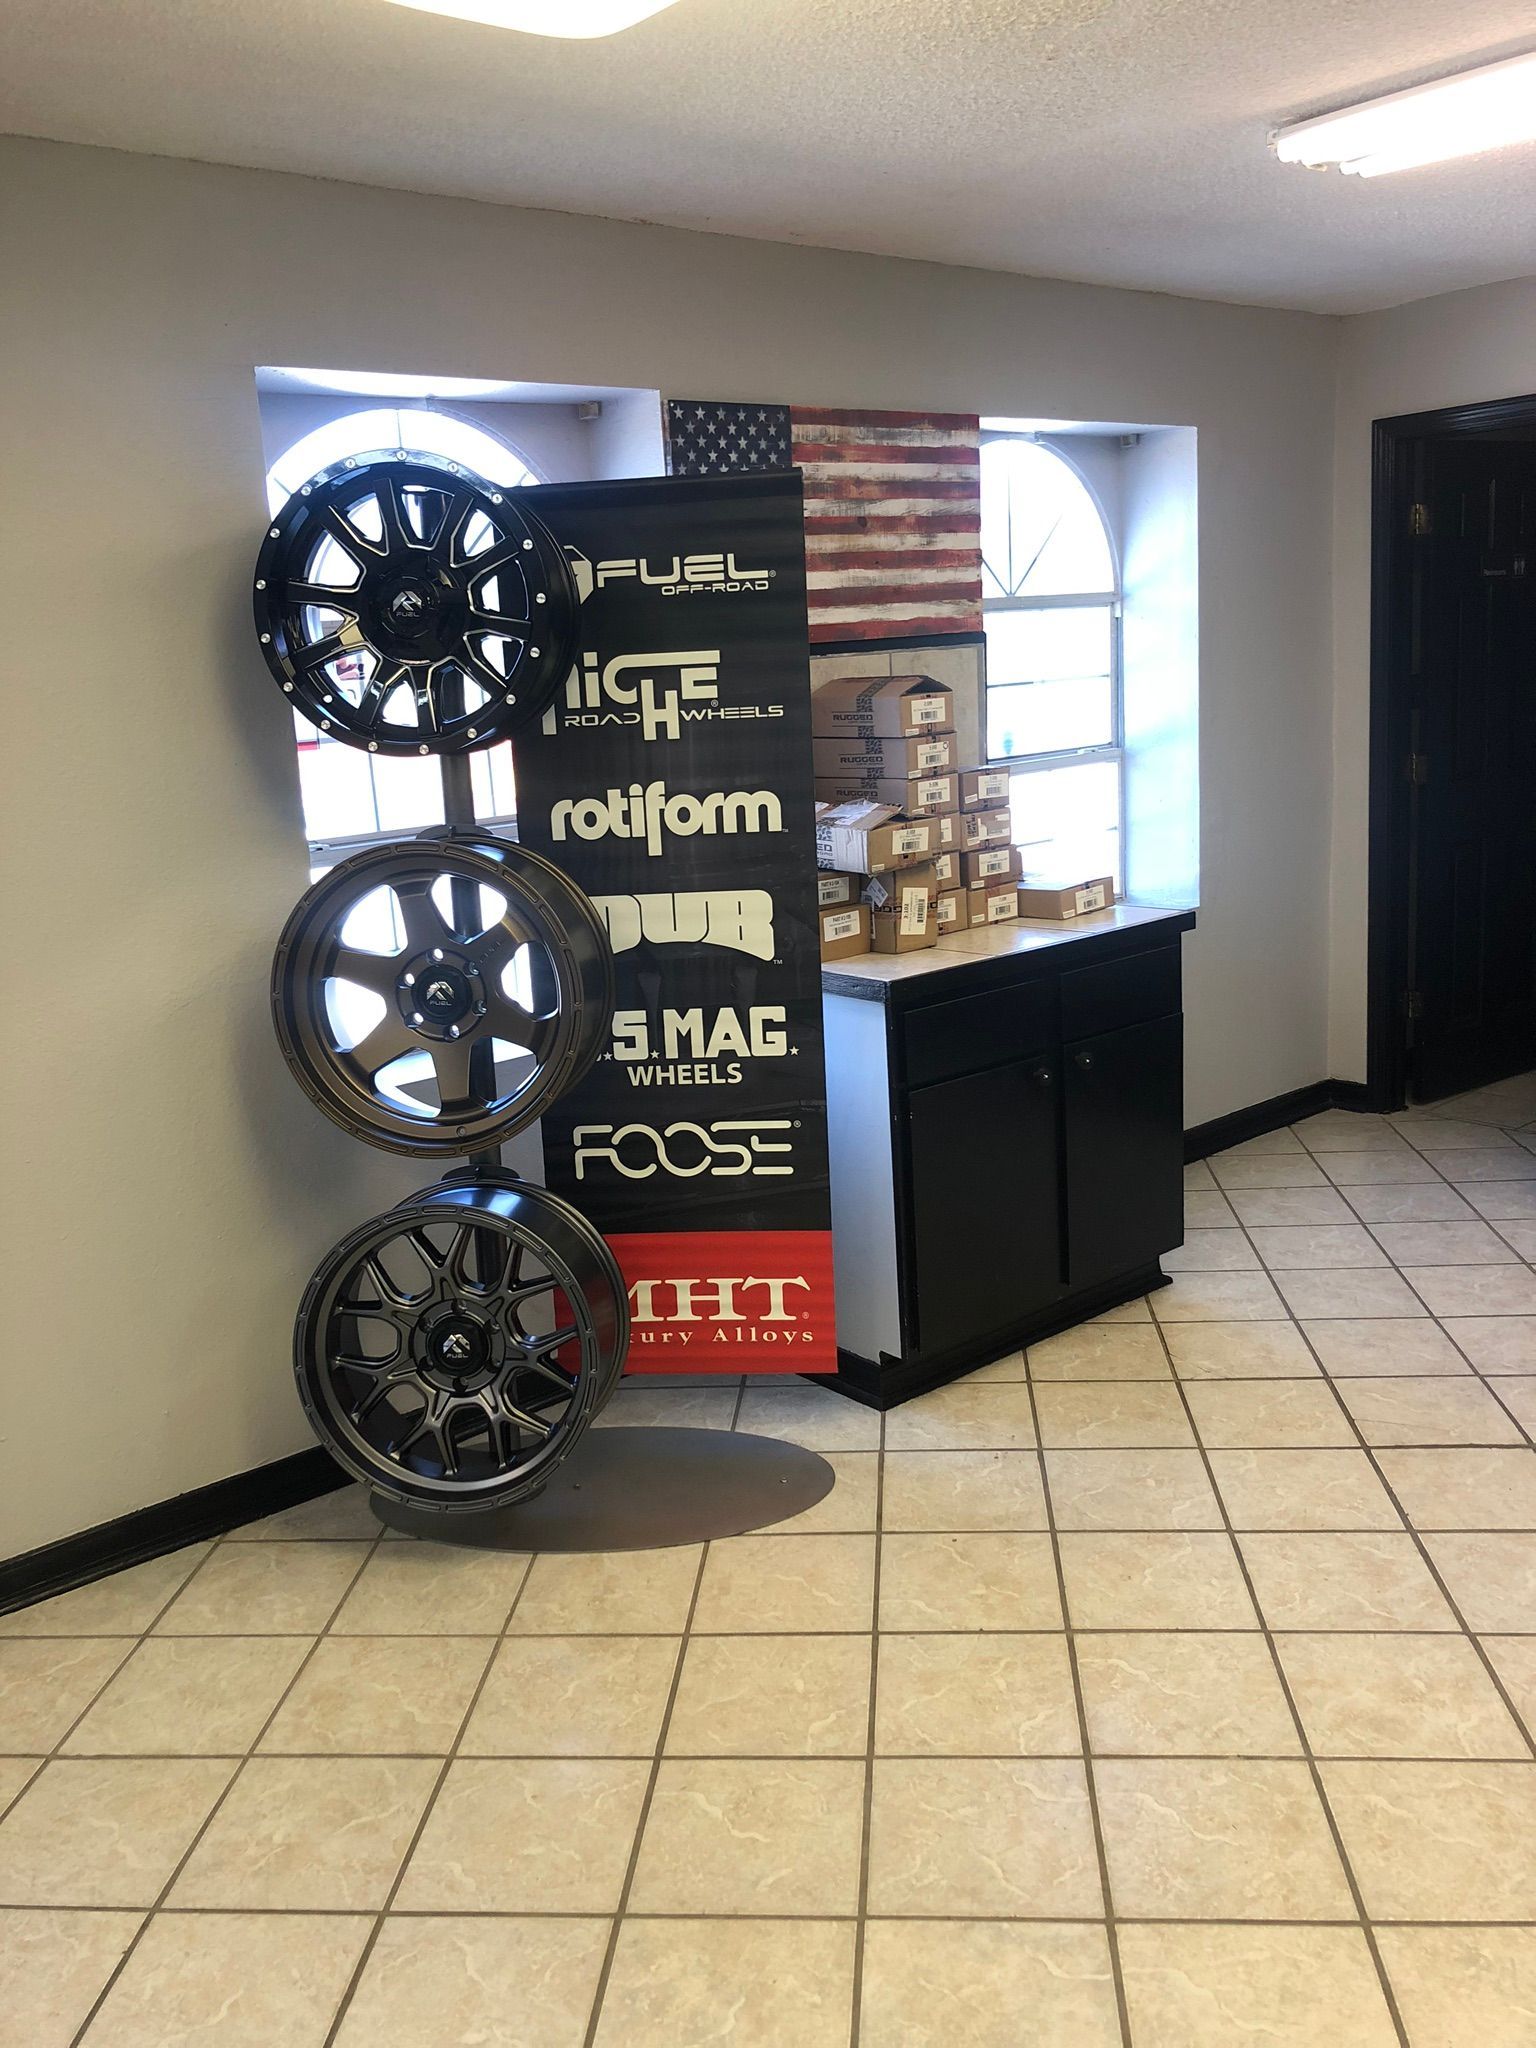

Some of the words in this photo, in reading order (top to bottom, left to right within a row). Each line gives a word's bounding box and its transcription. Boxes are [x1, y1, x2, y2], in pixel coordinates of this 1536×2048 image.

[596, 553, 769, 588] FUEL
[661, 581, 769, 596] OFF-ROAD
[564, 711, 641, 728] ROAD
[680, 704, 784, 721] WHEELS
[832, 713, 874, 721] RUGGED
[839, 755, 884, 763] RUGGED
[550, 780, 783, 857] rotiform
[626, 1062, 744, 1087] WHEELS
[572, 1119, 795, 1181] FOOSE
[711, 1326, 814, 1346] Alloys
